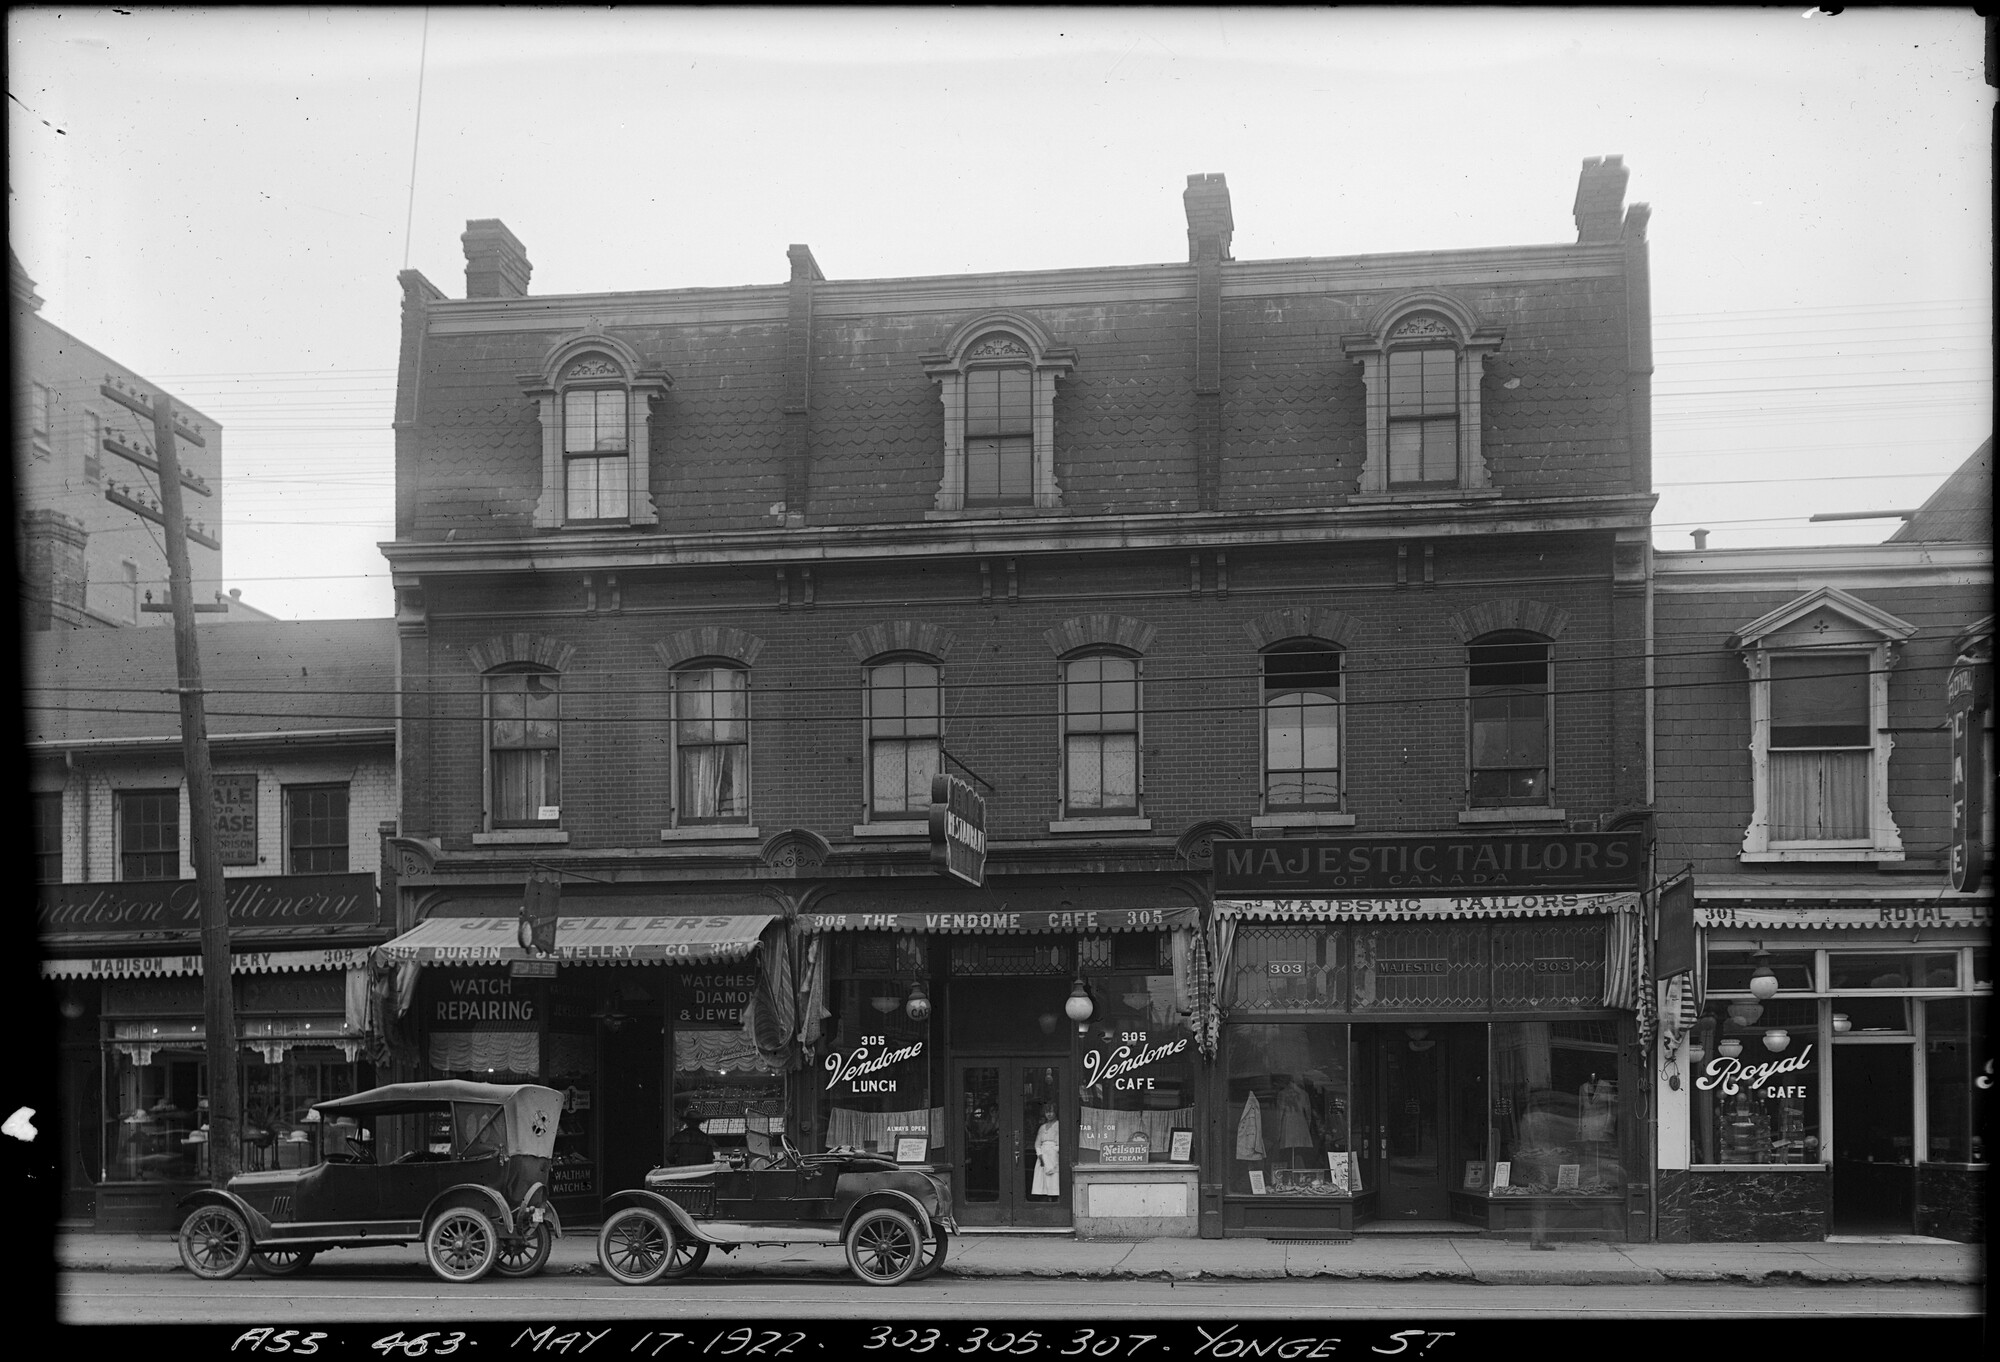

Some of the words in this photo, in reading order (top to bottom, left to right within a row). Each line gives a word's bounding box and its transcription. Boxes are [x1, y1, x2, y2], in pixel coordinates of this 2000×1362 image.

[216, 779, 239, 787] OR
[213, 788, 253, 804] ALE
[1953, 710, 1964, 874] CAFE
[214, 815, 254, 832] ASE
[1226, 845, 1437, 875] MAJESTIC
[1448, 841, 1630, 871] TAILORS
[1333, 875, 1366, 886] OF
[1388, 873, 1509, 885] CANADA
[1235, 900, 1263, 915] 303
[1272, 898, 1422, 913] MAJESTIC
[1450, 894, 1579, 911] TAILORS
[814, 914, 847, 927] 305
[862, 914, 898, 927] THE
[925, 913, 1021, 928] VENDOME
[1048, 911, 1099, 927] CAFE
[1127, 910, 1163, 925] 305
[1705, 907, 1736, 920] 301
[1880, 906, 1951, 921] ROYAL
[459, 916, 733, 931] JEELLERS
[388, 946, 420, 959] 307
[434, 946, 501, 959] DURBIN
[91, 957, 163, 972] MADISON
[182, 953, 271, 969] MINERY
[323, 949, 353, 964] 309
[1379, 961, 1444, 973] MAJESTIC
[1538, 961, 1571, 973] 303
[1270, 963, 1302, 974] 303
[450, 978, 512, 995] WATCH
[680, 973, 756, 989] WATCHES
[695, 990, 756, 1005] DIAMON
[436, 1000, 534, 1021] REPAIRING
[680, 1009, 691, 1021] &
[695, 1006, 744, 1021] JEWEL
[911, 1008, 930, 1018] CAF
[860, 1035, 886, 1046] 305
[1121, 1031, 1147, 1042] 305
[824, 1041, 924, 1091] Vendome
[1083, 1038, 1188, 1089] Vendome
[1695, 1043, 1814, 1096] Royal
[851, 1079, 897, 1093] LUNCH
[1114, 1077, 1156, 1091] CAFE
[1766, 1085, 1807, 1099] CAFE
[1102, 1144, 1147, 1158] Neilson's
[554, 1169, 591, 1181] WALTHAM
[552, 1181, 592, 1193] WATCHES
